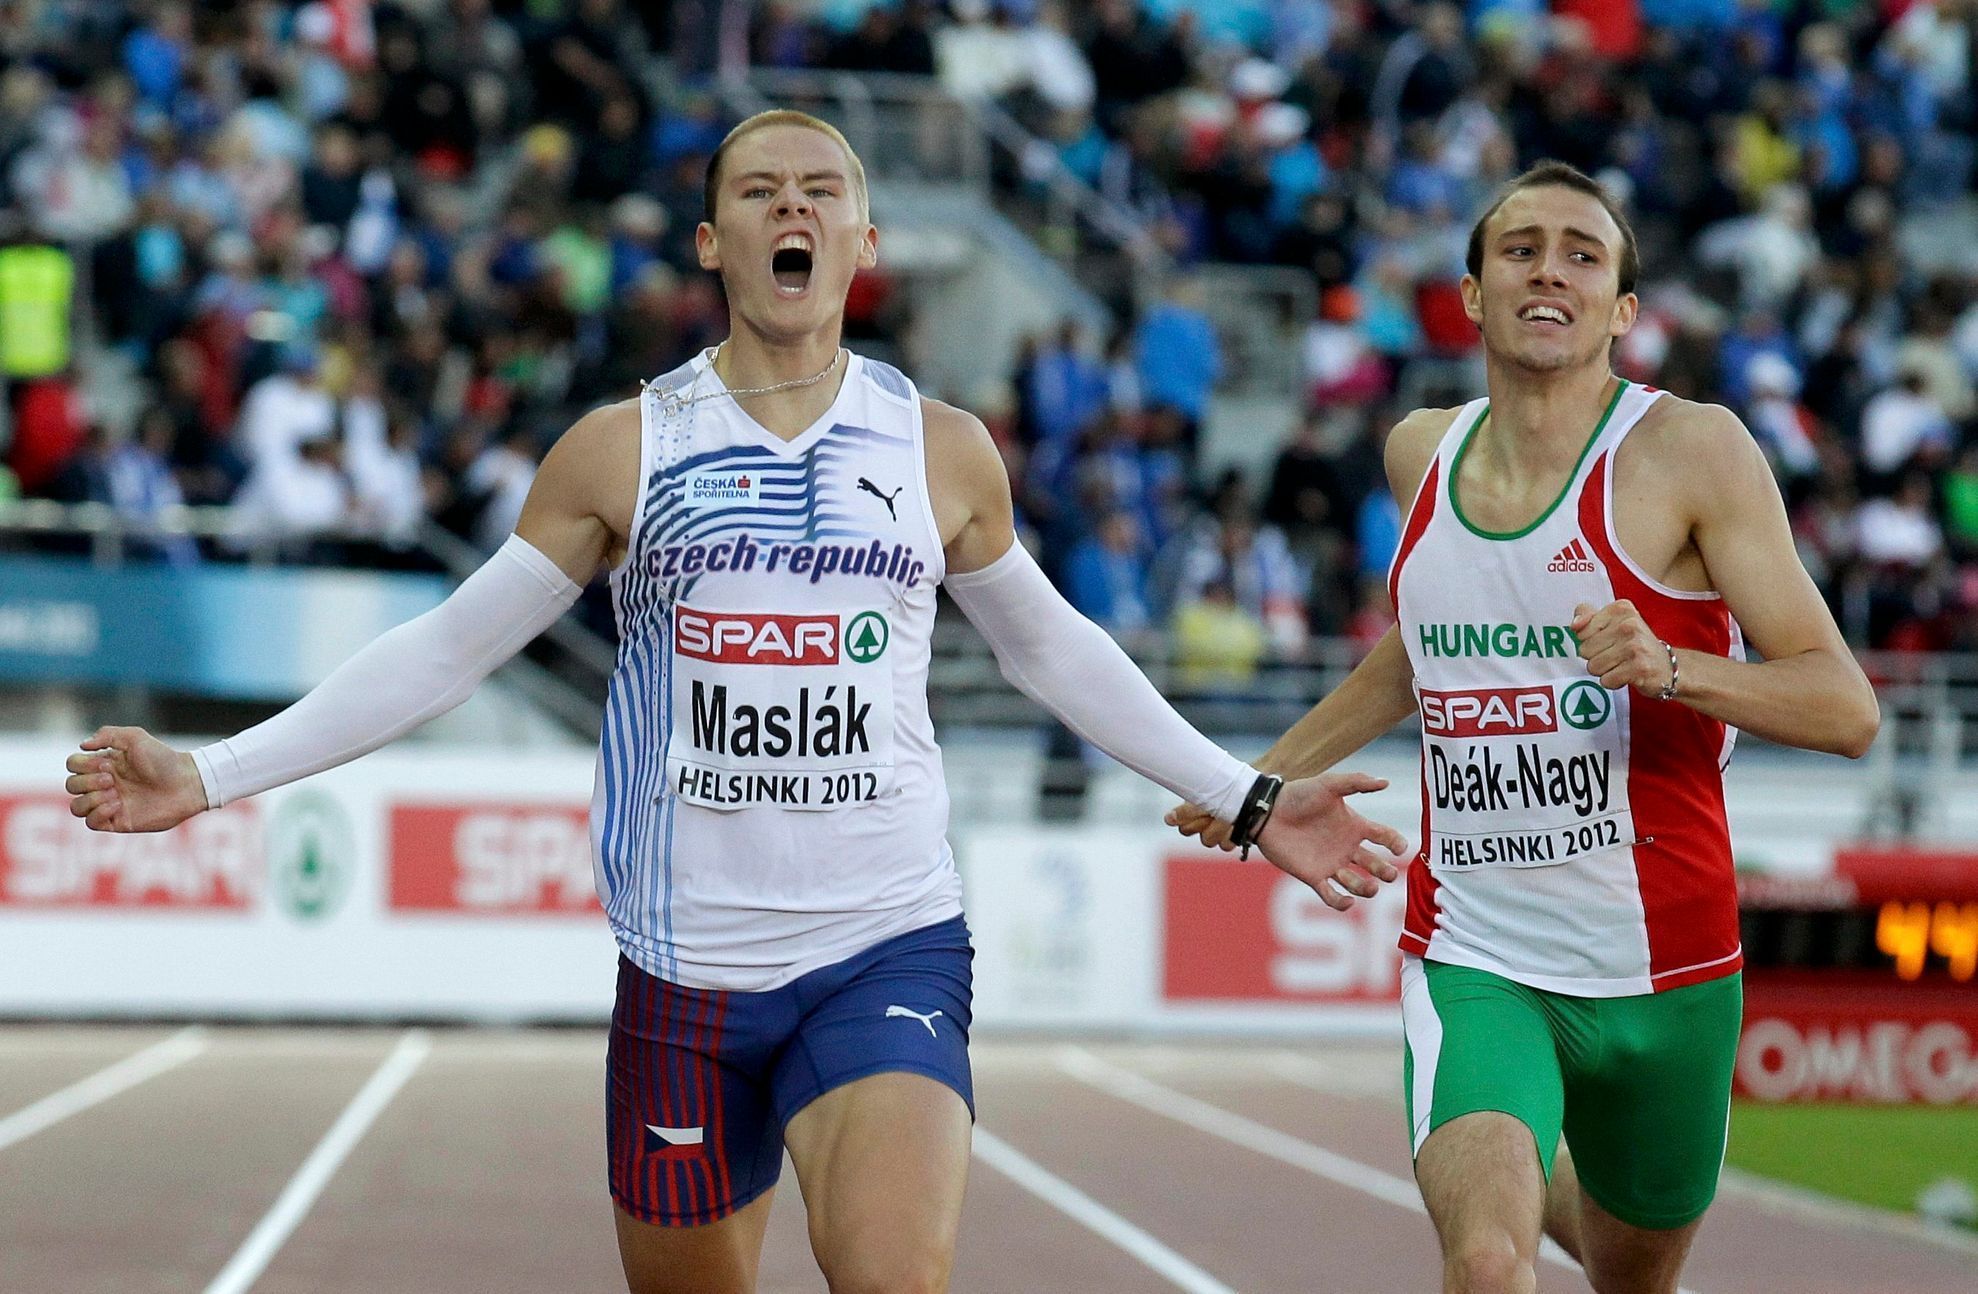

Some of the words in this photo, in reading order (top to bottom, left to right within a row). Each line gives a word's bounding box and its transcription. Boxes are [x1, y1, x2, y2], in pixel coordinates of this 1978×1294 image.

[693, 476, 737, 489] ČESKÁ
[766, 540, 924, 588] republic
[1547, 559, 1595, 573] adidas
[677, 614, 836, 660] SPAR
[692, 680, 871, 757] Maslák
[1424, 694, 1553, 731] SPAR
[678, 766, 809, 804] HELSINKI
[821, 771, 878, 804] 2012
[1429, 744, 1611, 817] Deák-Nagy
[1441, 834, 1554, 866] HELSINKI
[1562, 820, 1620, 856] 2012
